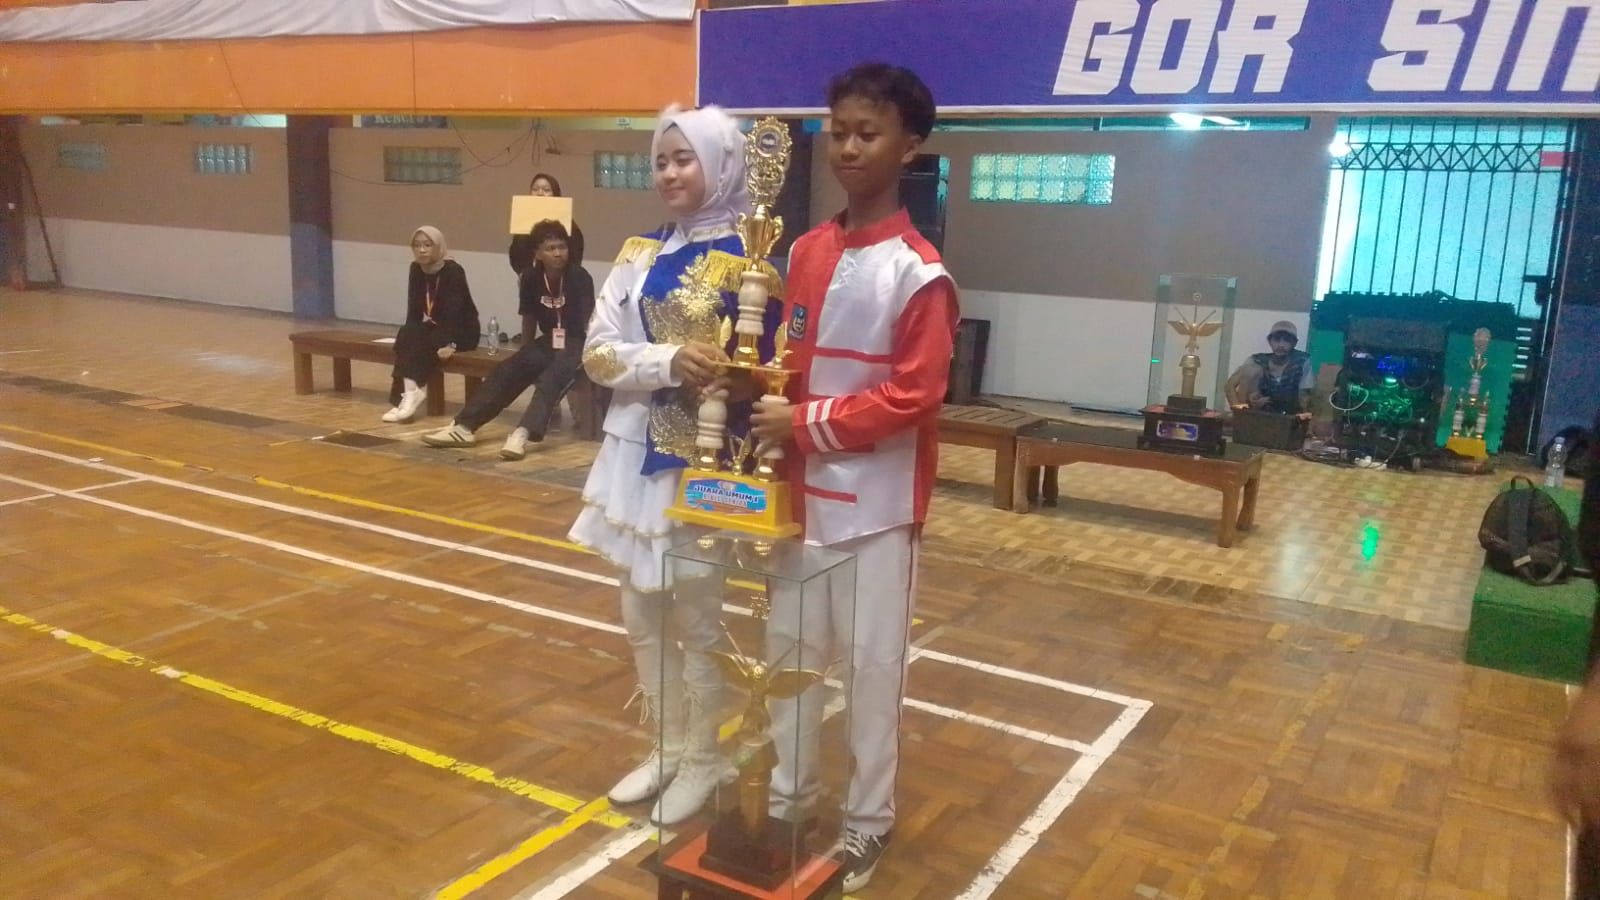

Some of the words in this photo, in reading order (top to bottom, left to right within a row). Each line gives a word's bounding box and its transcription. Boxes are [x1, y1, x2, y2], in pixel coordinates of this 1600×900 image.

[1052, 0, 1309, 95] GOR
[694, 484, 723, 496] JUARA
[725, 489, 753, 502] UMUM
